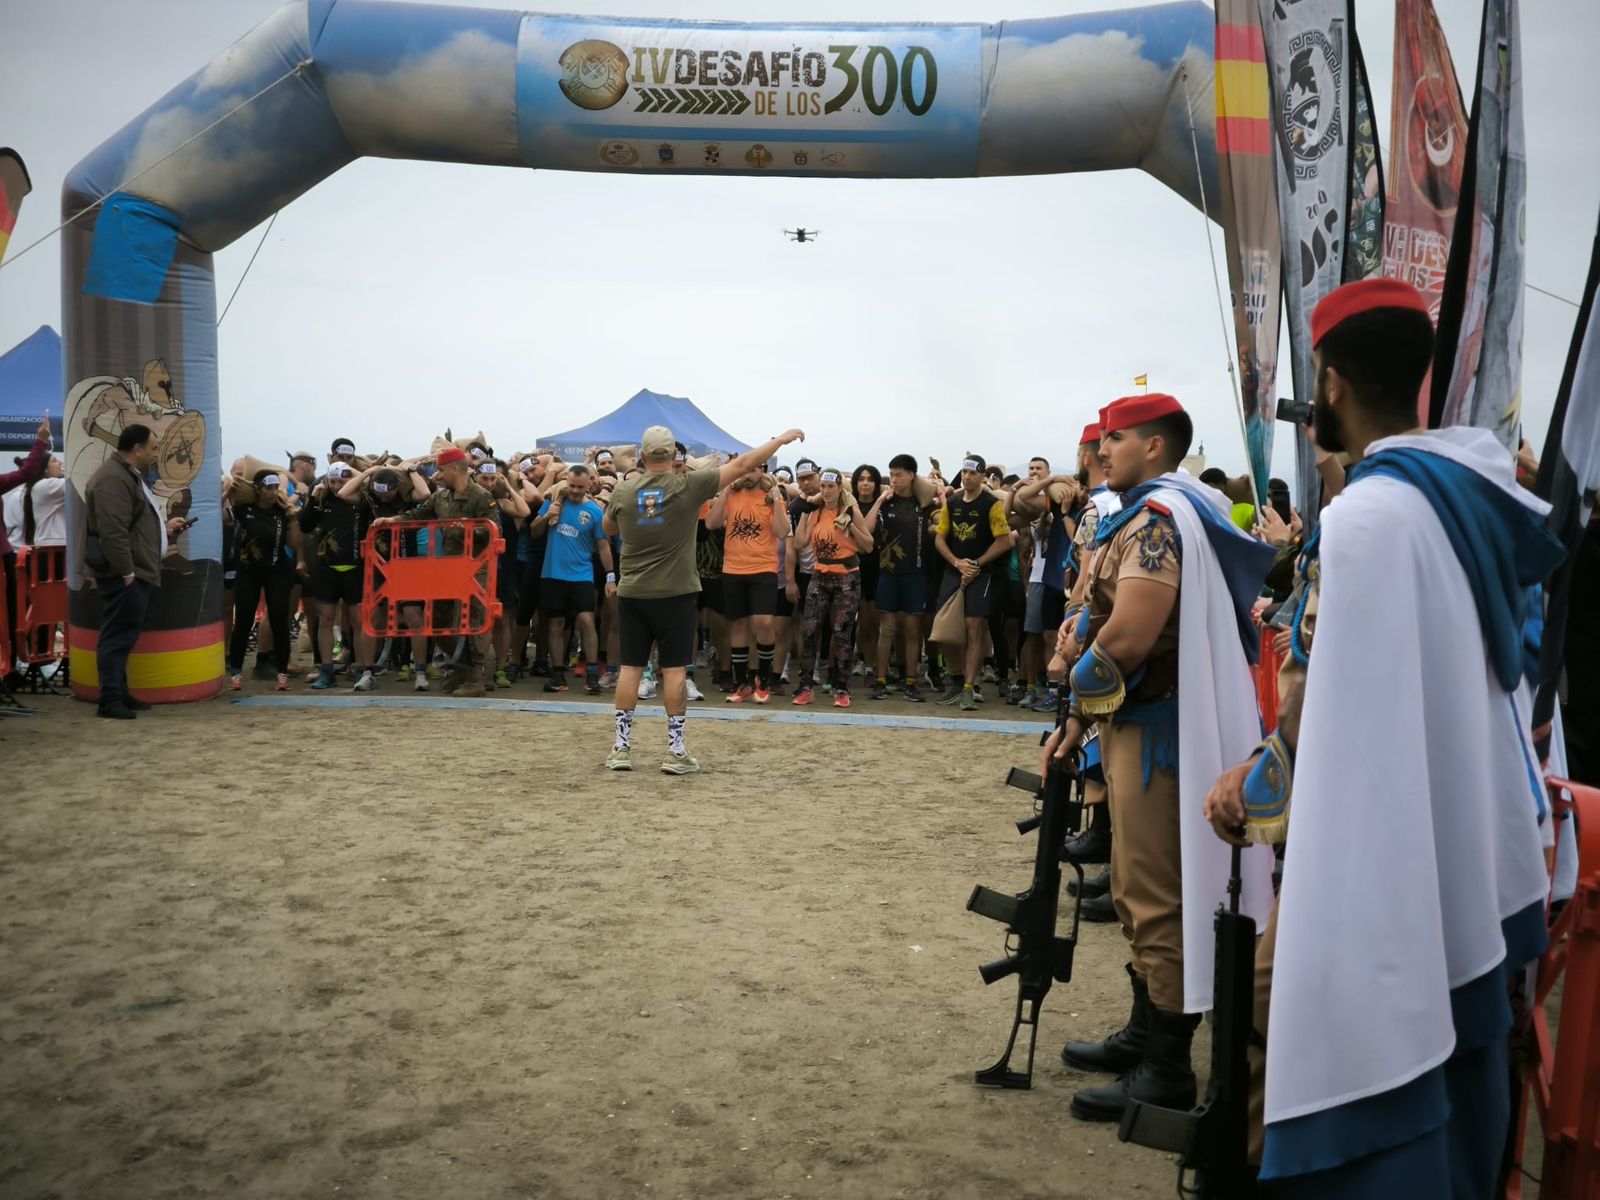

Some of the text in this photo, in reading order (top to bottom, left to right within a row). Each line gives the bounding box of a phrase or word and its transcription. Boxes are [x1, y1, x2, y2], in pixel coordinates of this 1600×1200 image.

[754, 91, 821, 116] DE LOS
[824, 45, 938, 116] 300
